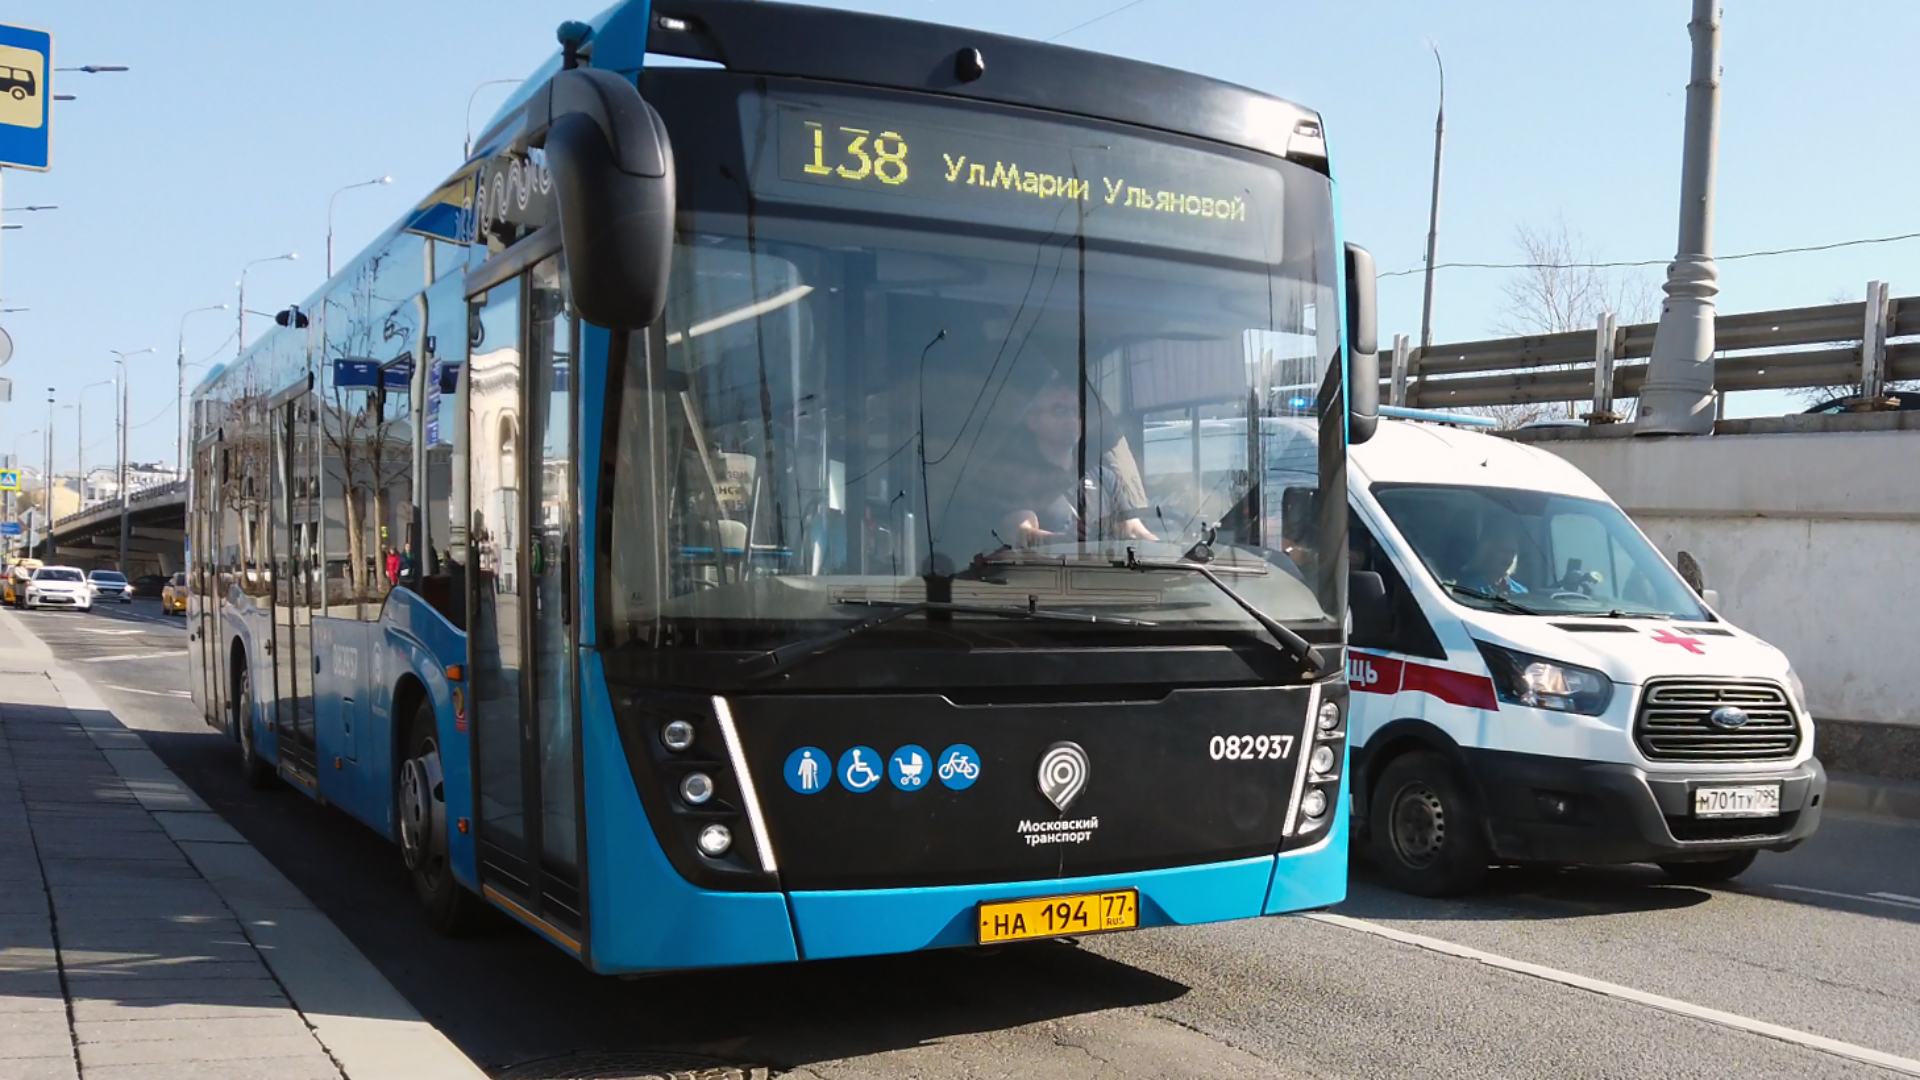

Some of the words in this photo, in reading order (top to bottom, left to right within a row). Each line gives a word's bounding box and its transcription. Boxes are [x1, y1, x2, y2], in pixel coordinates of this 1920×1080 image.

[803, 121, 909, 185] 138
[942, 153, 1090, 201] Ул.Марии
[1103, 177, 1246, 222] Ульяновой
[1209, 735, 1294, 760] 082937
[1017, 816, 1099, 833] Московский
[1024, 831, 1092, 847] транспорт
[994, 913, 1027, 936] НА
[1040, 901, 1088, 931] 194
[1103, 895, 1127, 917] 77
[1106, 917, 1125, 926] RUS
